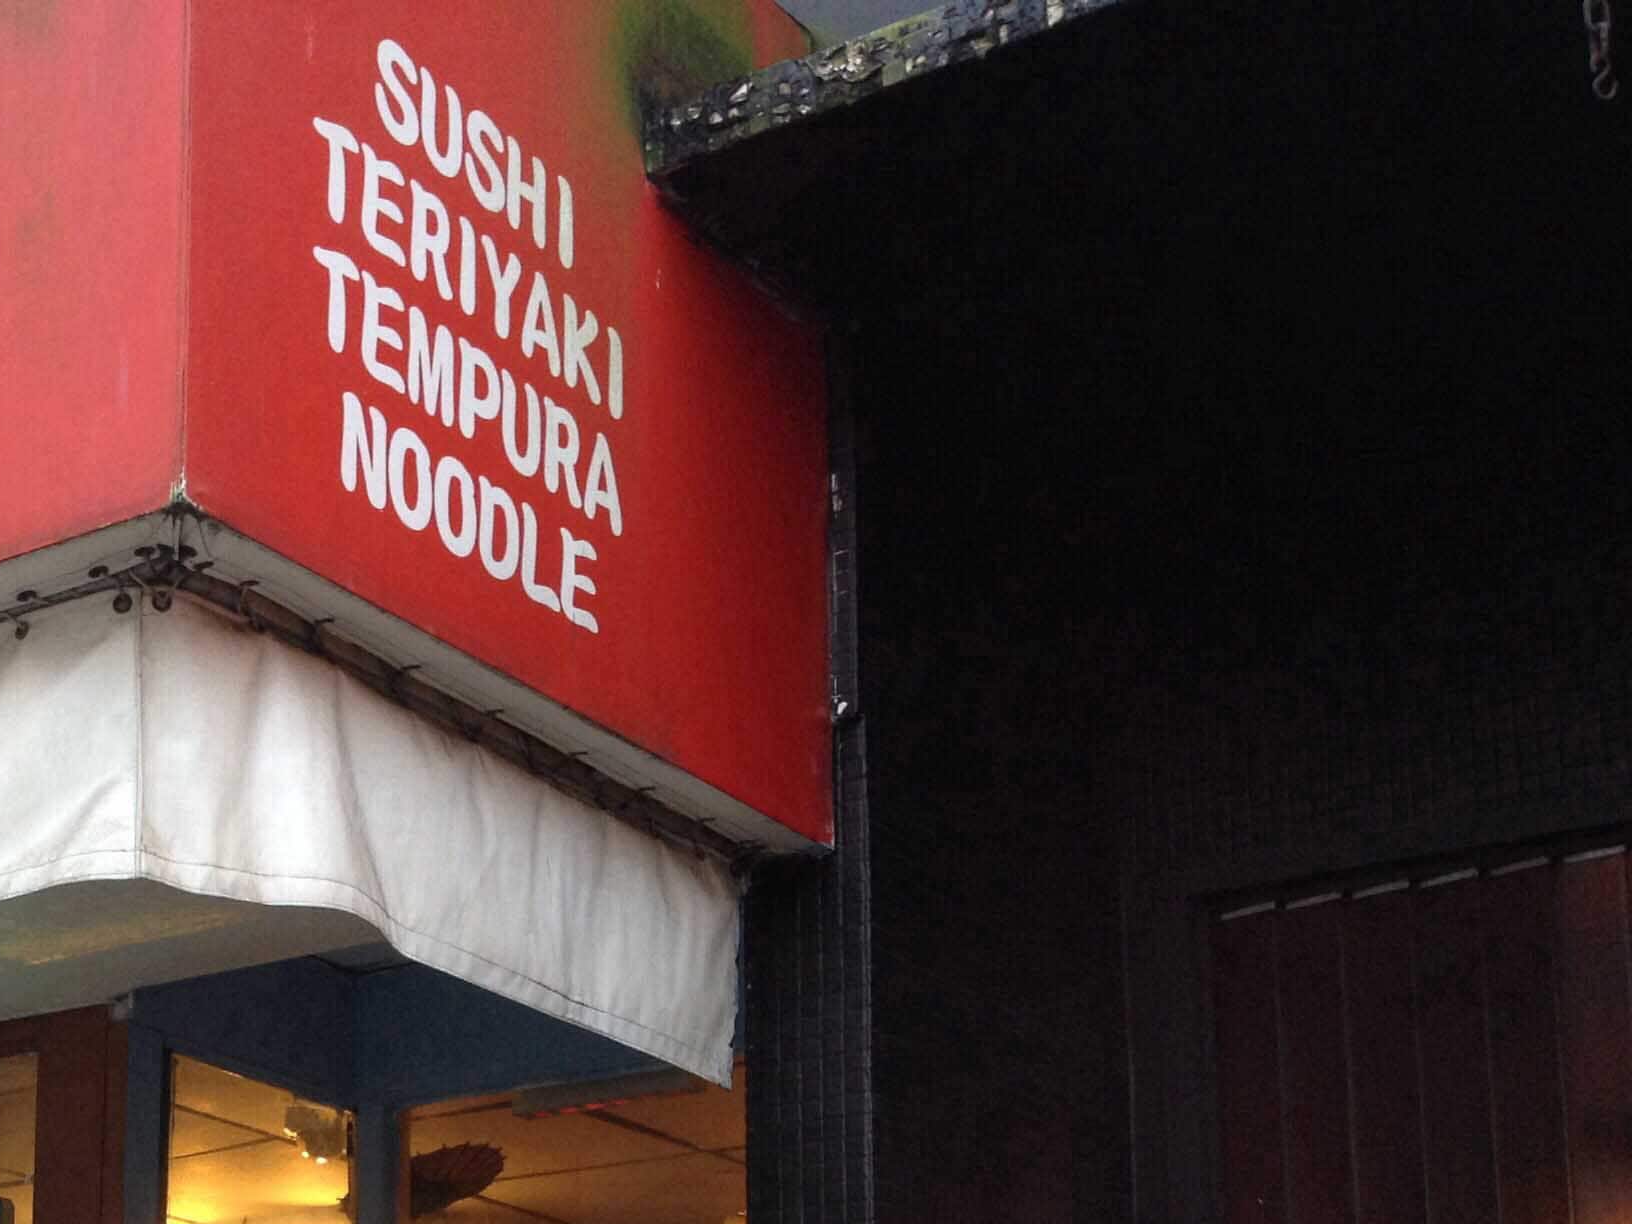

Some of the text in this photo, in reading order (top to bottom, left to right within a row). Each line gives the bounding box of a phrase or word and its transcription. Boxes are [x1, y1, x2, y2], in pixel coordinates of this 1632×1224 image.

[313, 116, 623, 420] TERIYAKI
[375, 38, 574, 268] SUSHI
[313, 246, 623, 536] TEMPURA
[340, 391, 598, 633] NOODLE
